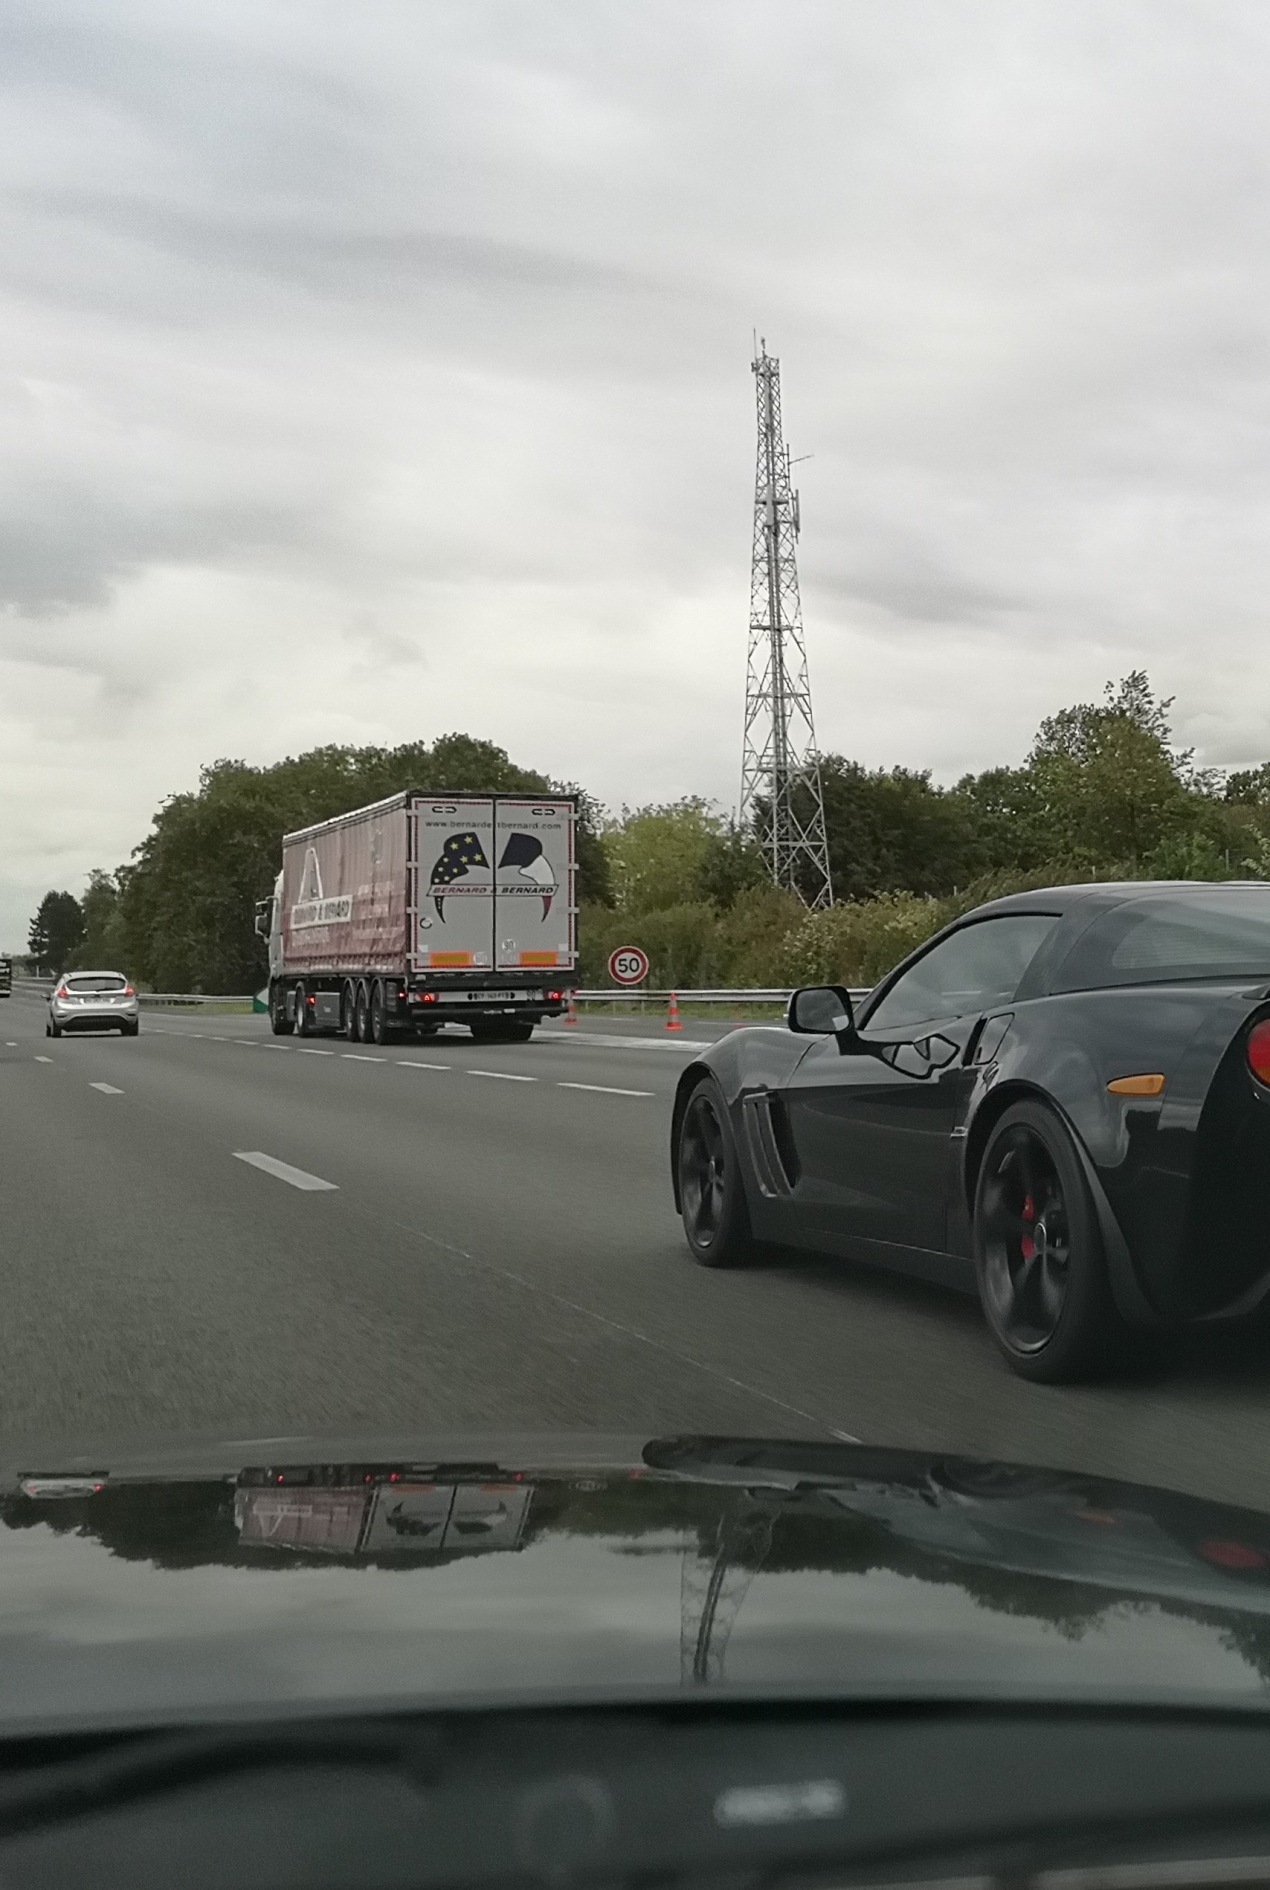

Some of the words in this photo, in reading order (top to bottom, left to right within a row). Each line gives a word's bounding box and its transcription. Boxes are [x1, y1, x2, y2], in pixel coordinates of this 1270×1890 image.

[433, 886, 488, 894] BERNARD
[501, 886, 554, 894] BERNARD
[618, 957, 640, 973] 50
